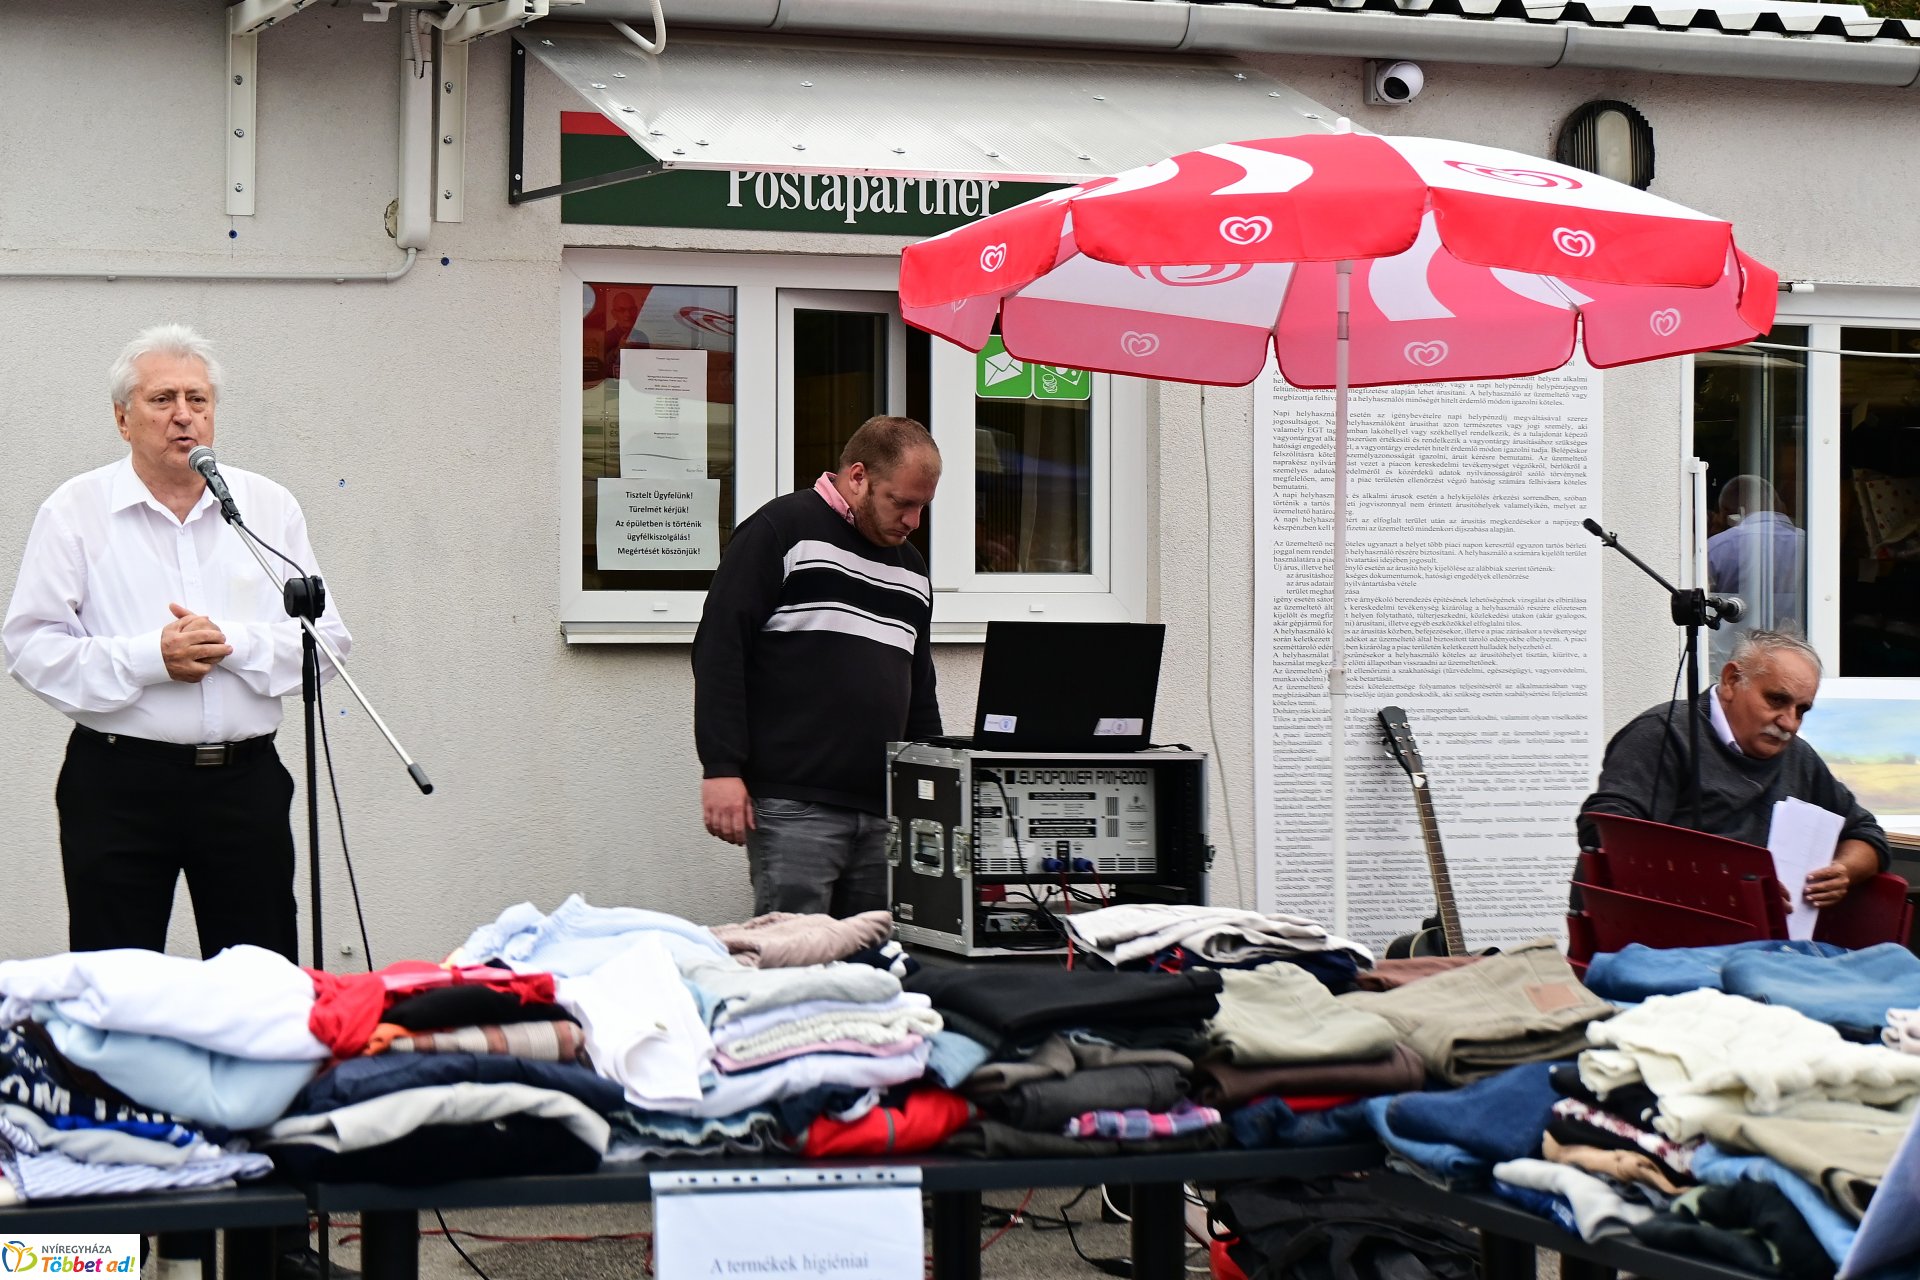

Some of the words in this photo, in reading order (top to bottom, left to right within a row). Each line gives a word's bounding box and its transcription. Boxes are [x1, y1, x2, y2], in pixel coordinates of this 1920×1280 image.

[727, 170, 999, 224] Postapartner
[654, 491, 693, 501] Ügyfelünk!
[629, 505, 661, 513] Türelmét
[663, 506, 688, 515] kérjük!
[626, 520, 662, 529] épületben
[664, 520, 671, 528] is
[673, 520, 702, 528] történik
[627, 533, 690, 542] ügyfélkiszolgálás!
[618, 547, 659, 556] Megértését
[662, 547, 700, 556] köszönjük!
[1019, 770, 1093, 785] EUROPOWER
[710, 1258, 723, 1275] A
[727, 1256, 798, 1274] termékek
[803, 1251, 869, 1275] higiéniai
